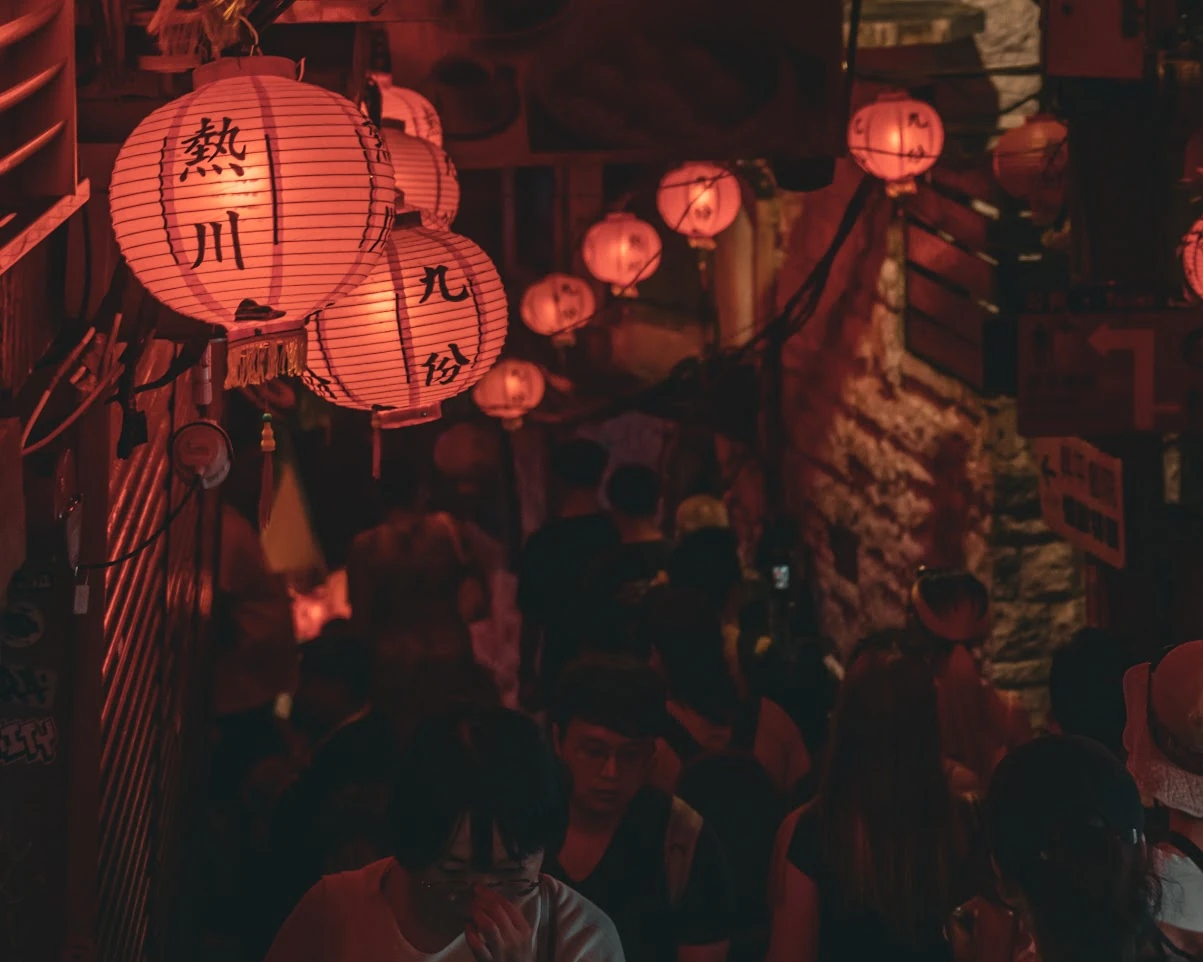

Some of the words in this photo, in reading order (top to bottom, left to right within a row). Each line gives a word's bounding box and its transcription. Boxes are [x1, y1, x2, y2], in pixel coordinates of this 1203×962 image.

[180, 115, 247, 271] 熱川
[418, 264, 471, 387] 九份
[0, 721, 55, 764] ITY
